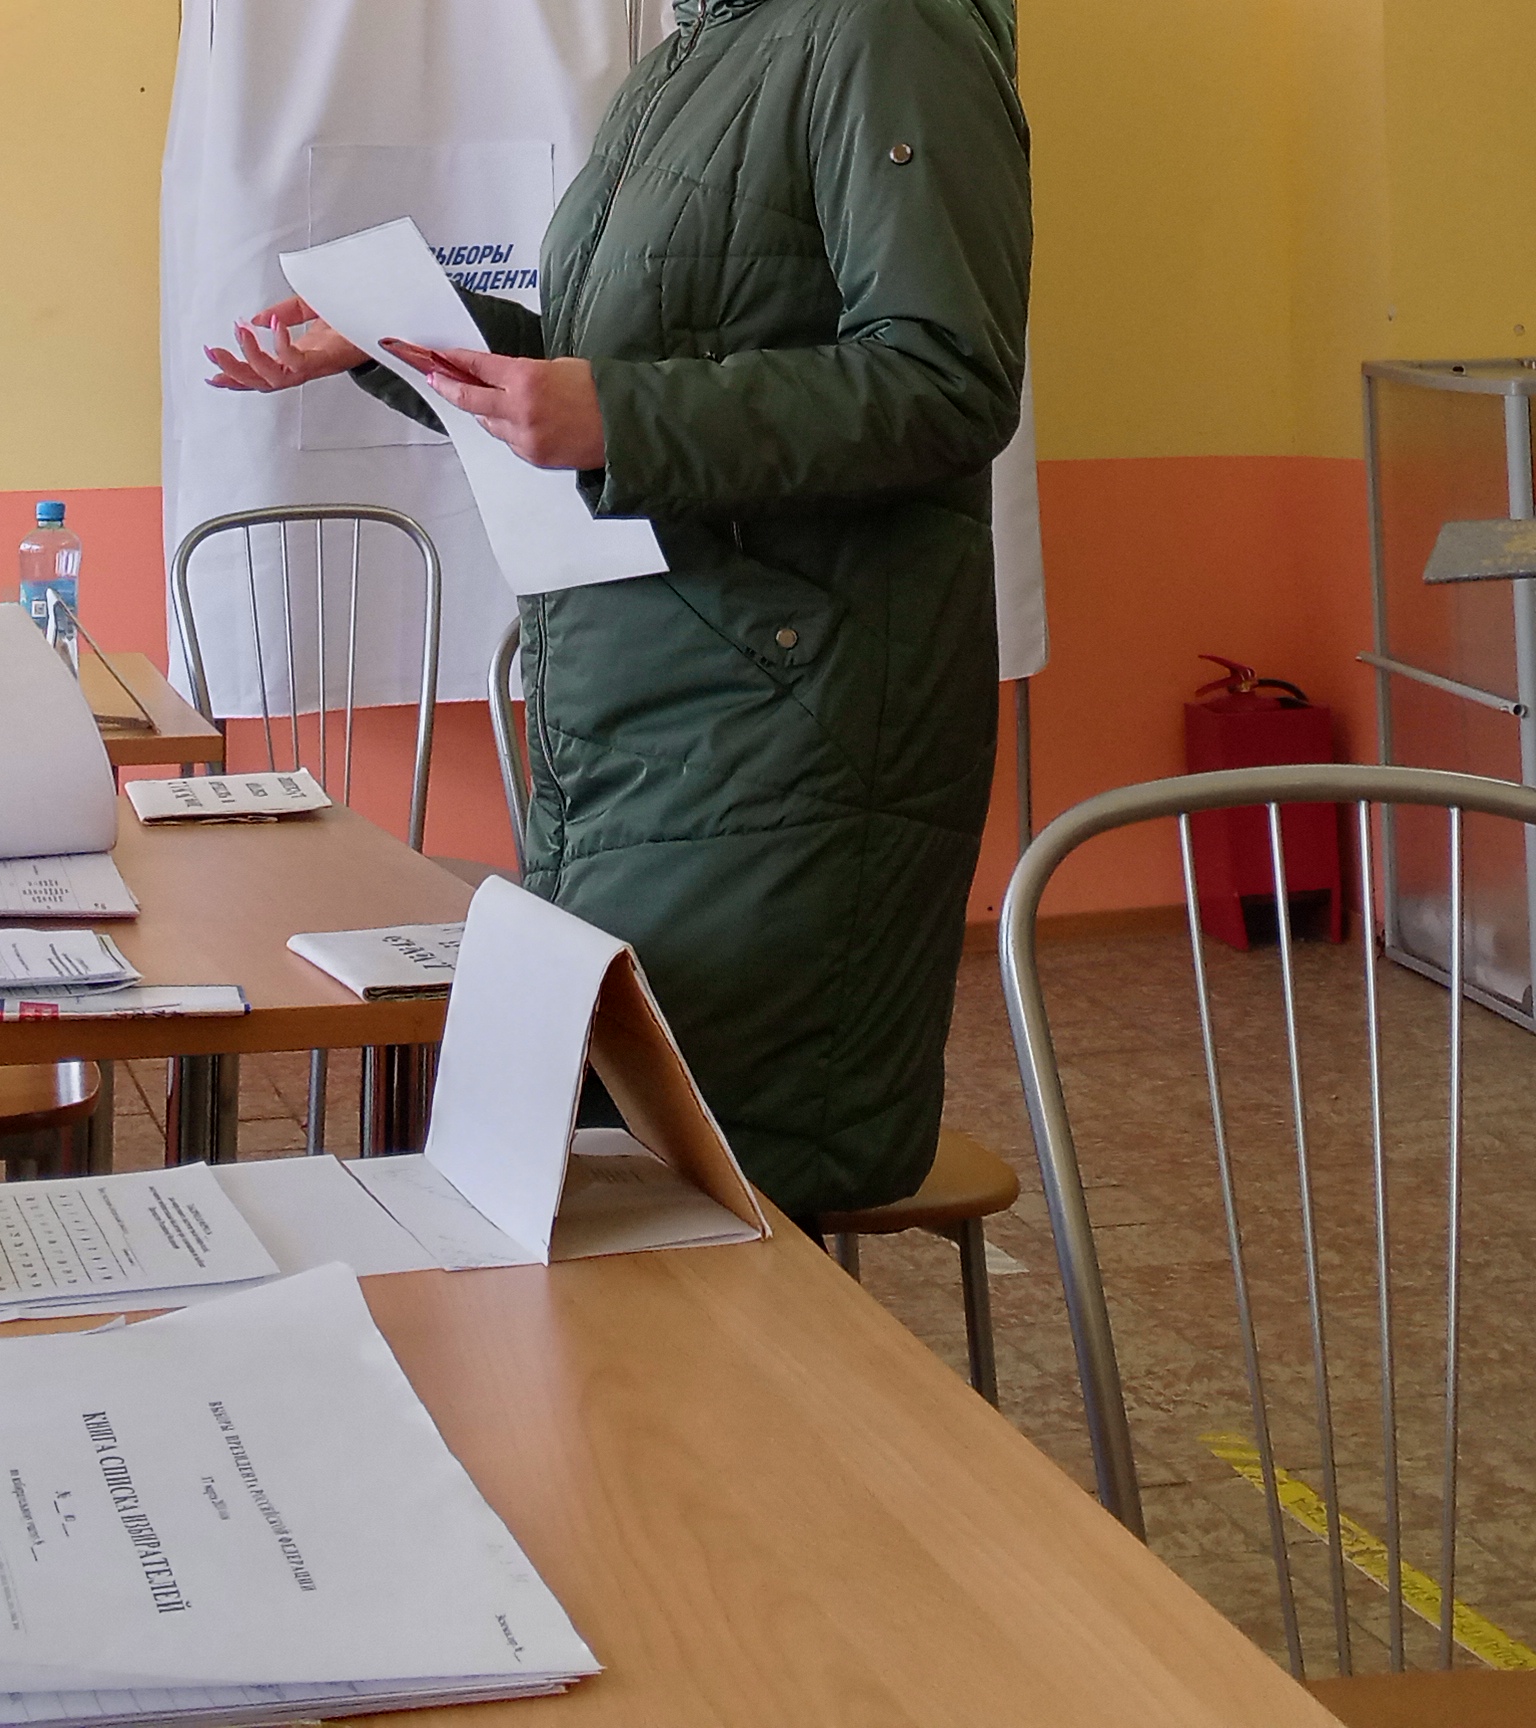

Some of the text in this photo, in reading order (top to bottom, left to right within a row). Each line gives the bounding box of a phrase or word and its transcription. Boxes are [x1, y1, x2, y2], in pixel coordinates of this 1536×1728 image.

[445, 269, 538, 292] ЗИДЕНТА
[82, 1411, 192, 1614] КНИГА СПИСКА ИЗБИРАТЕЛЕЙ
